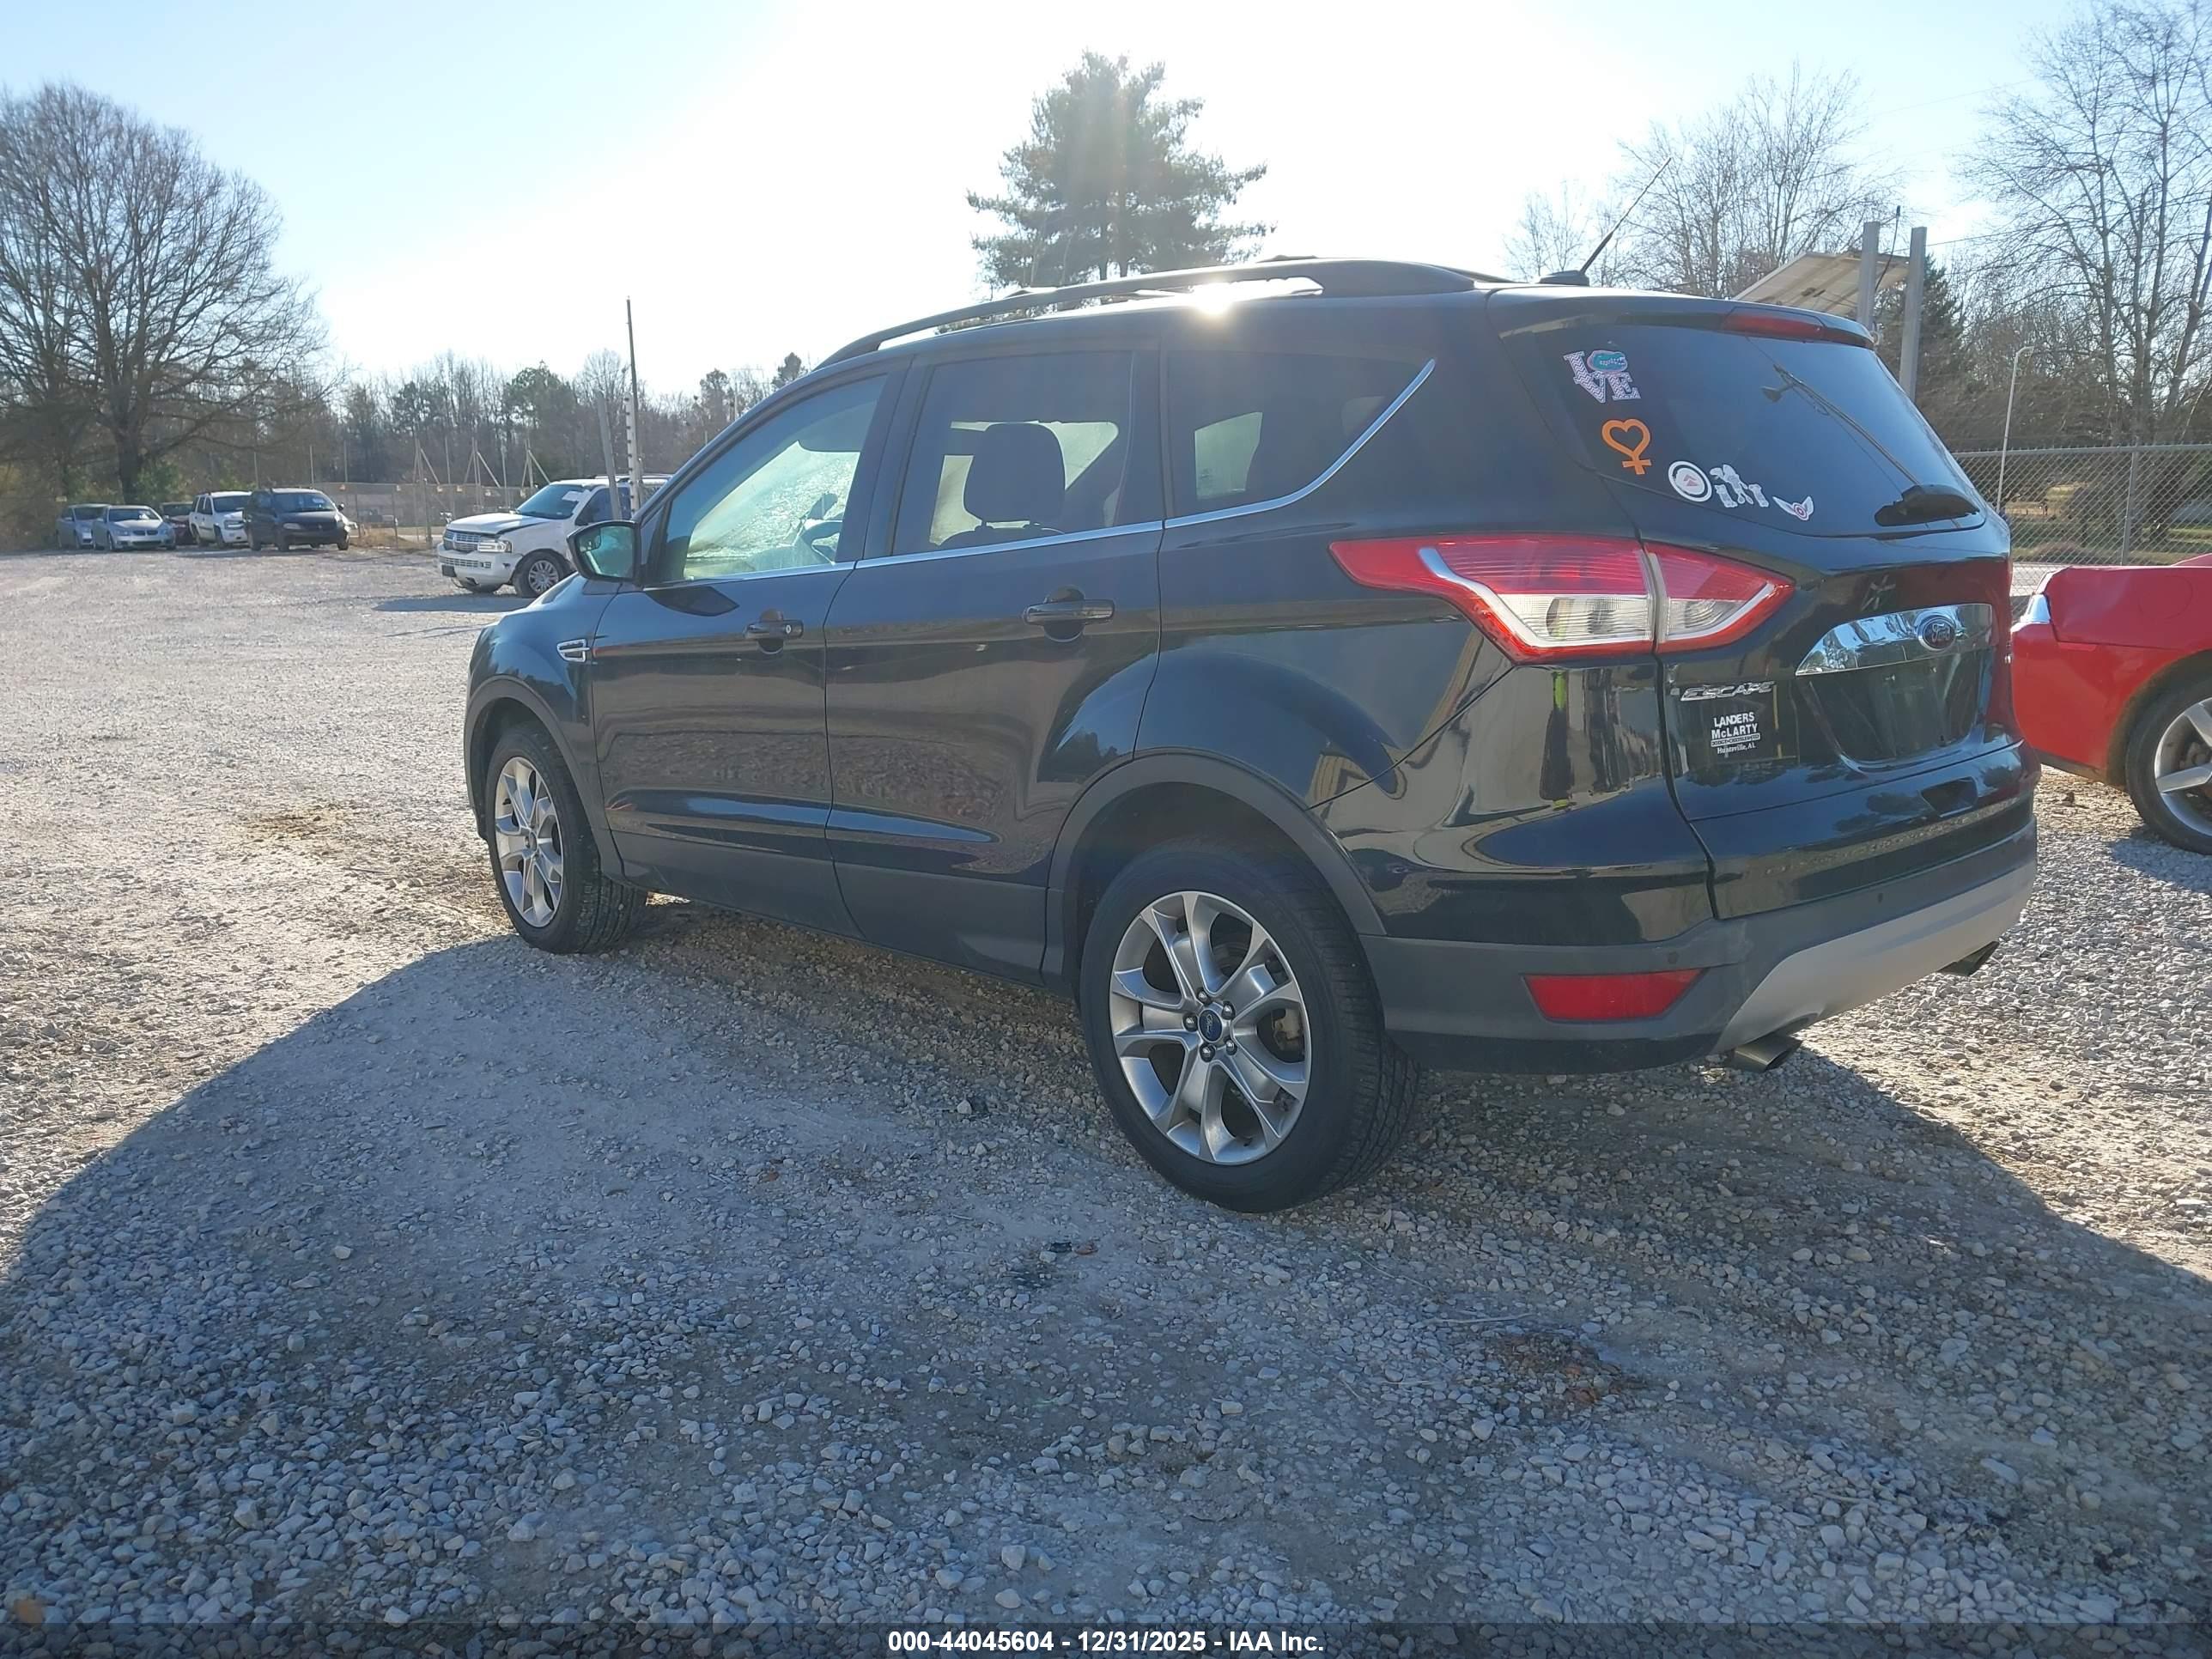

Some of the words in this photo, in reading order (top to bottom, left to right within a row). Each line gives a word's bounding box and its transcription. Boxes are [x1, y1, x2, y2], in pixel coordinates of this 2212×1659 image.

[1680, 681, 1773, 701] ESCAPE
[1713, 712, 1754, 728] LANDERS
[1711, 723, 1758, 739] McLARTY
